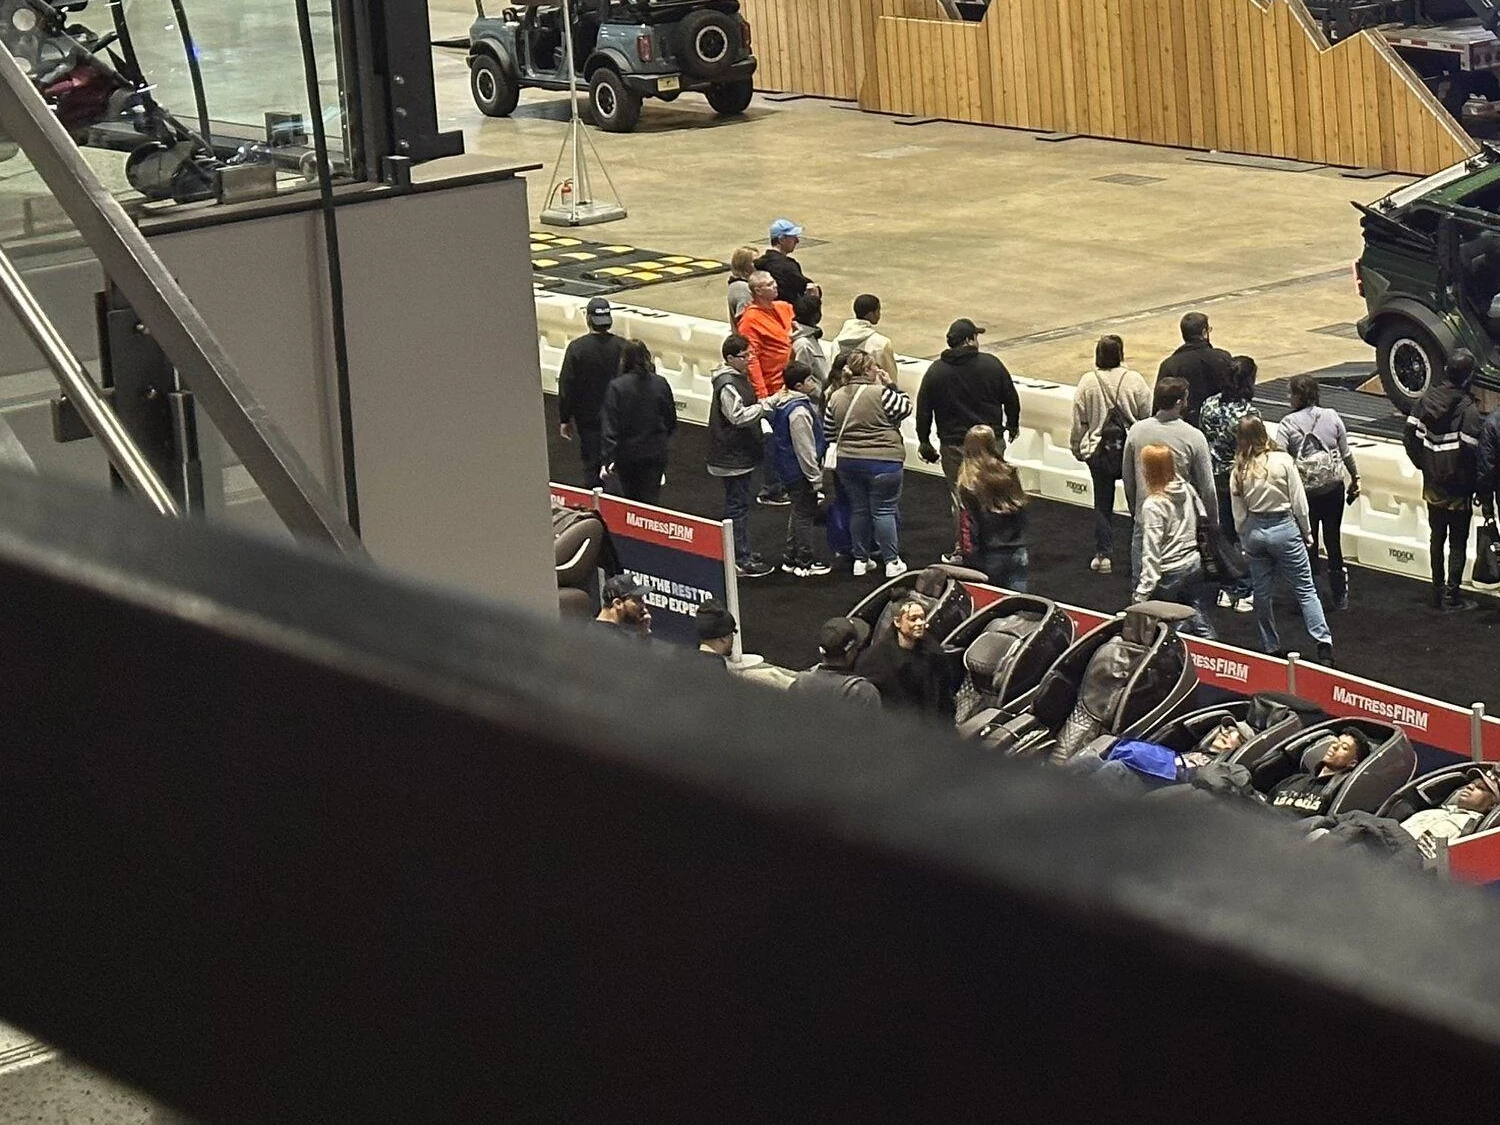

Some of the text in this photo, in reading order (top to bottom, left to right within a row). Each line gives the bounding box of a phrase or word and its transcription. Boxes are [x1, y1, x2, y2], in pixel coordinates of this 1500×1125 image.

[1388, 548, 1415, 562] YODOCK
[650, 576, 671, 594] THE
[671, 582, 698, 601] REST
[642, 592, 668, 609] LEEP
